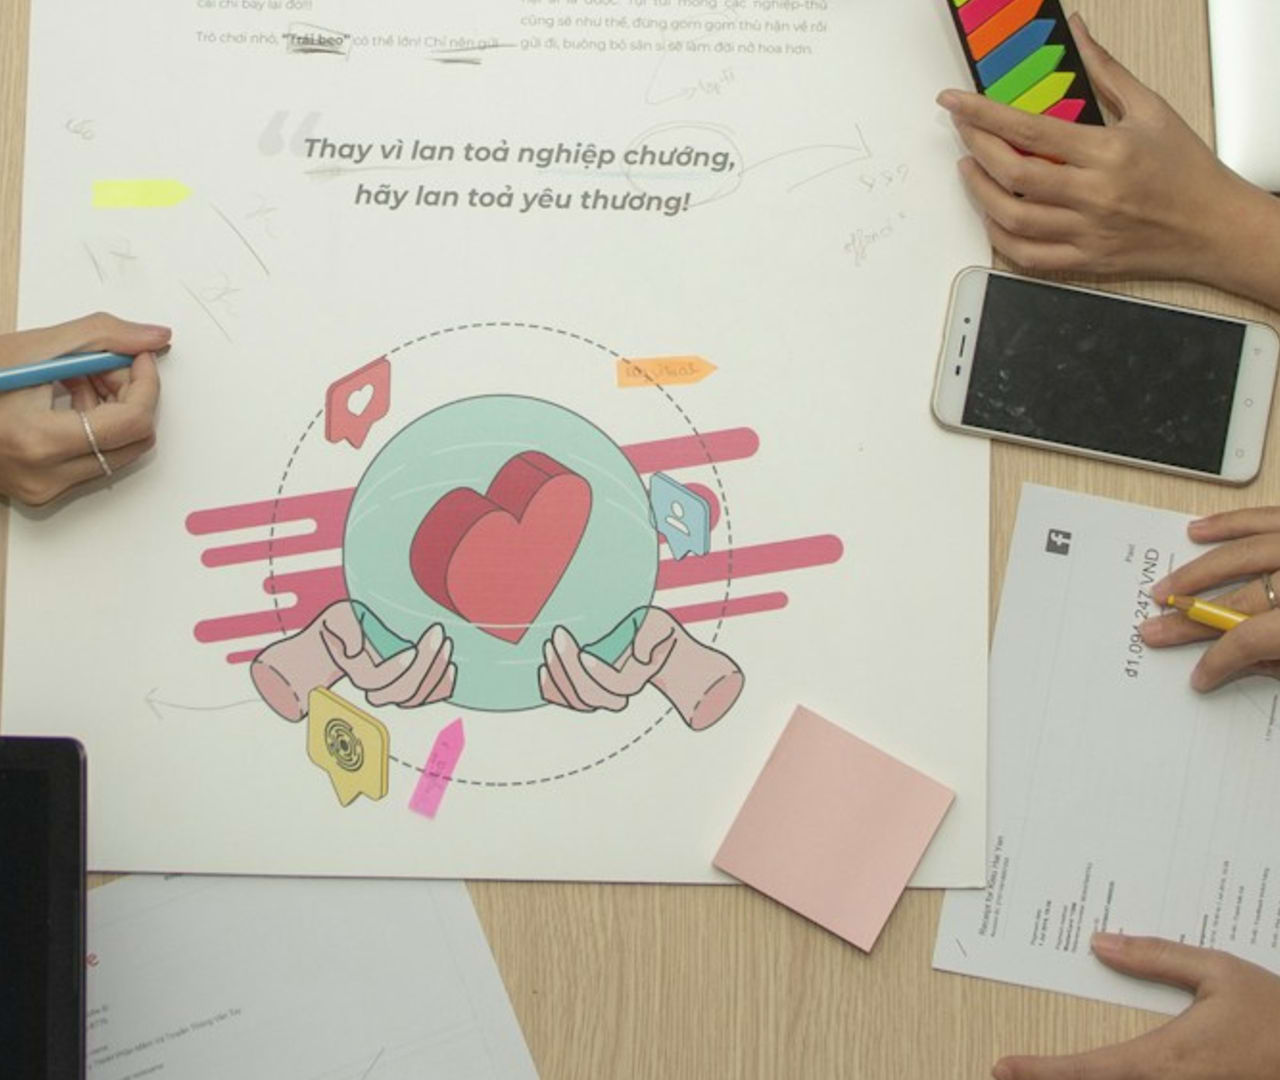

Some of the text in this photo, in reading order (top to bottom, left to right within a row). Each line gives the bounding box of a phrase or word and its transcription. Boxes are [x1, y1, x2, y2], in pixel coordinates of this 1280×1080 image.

[304, 138, 736, 172] Thay vì lan toả nghiệp chướng,
[354, 184, 690, 216] hãy lan toả yêu thương!
[1140, 548, 1159, 585] VND
